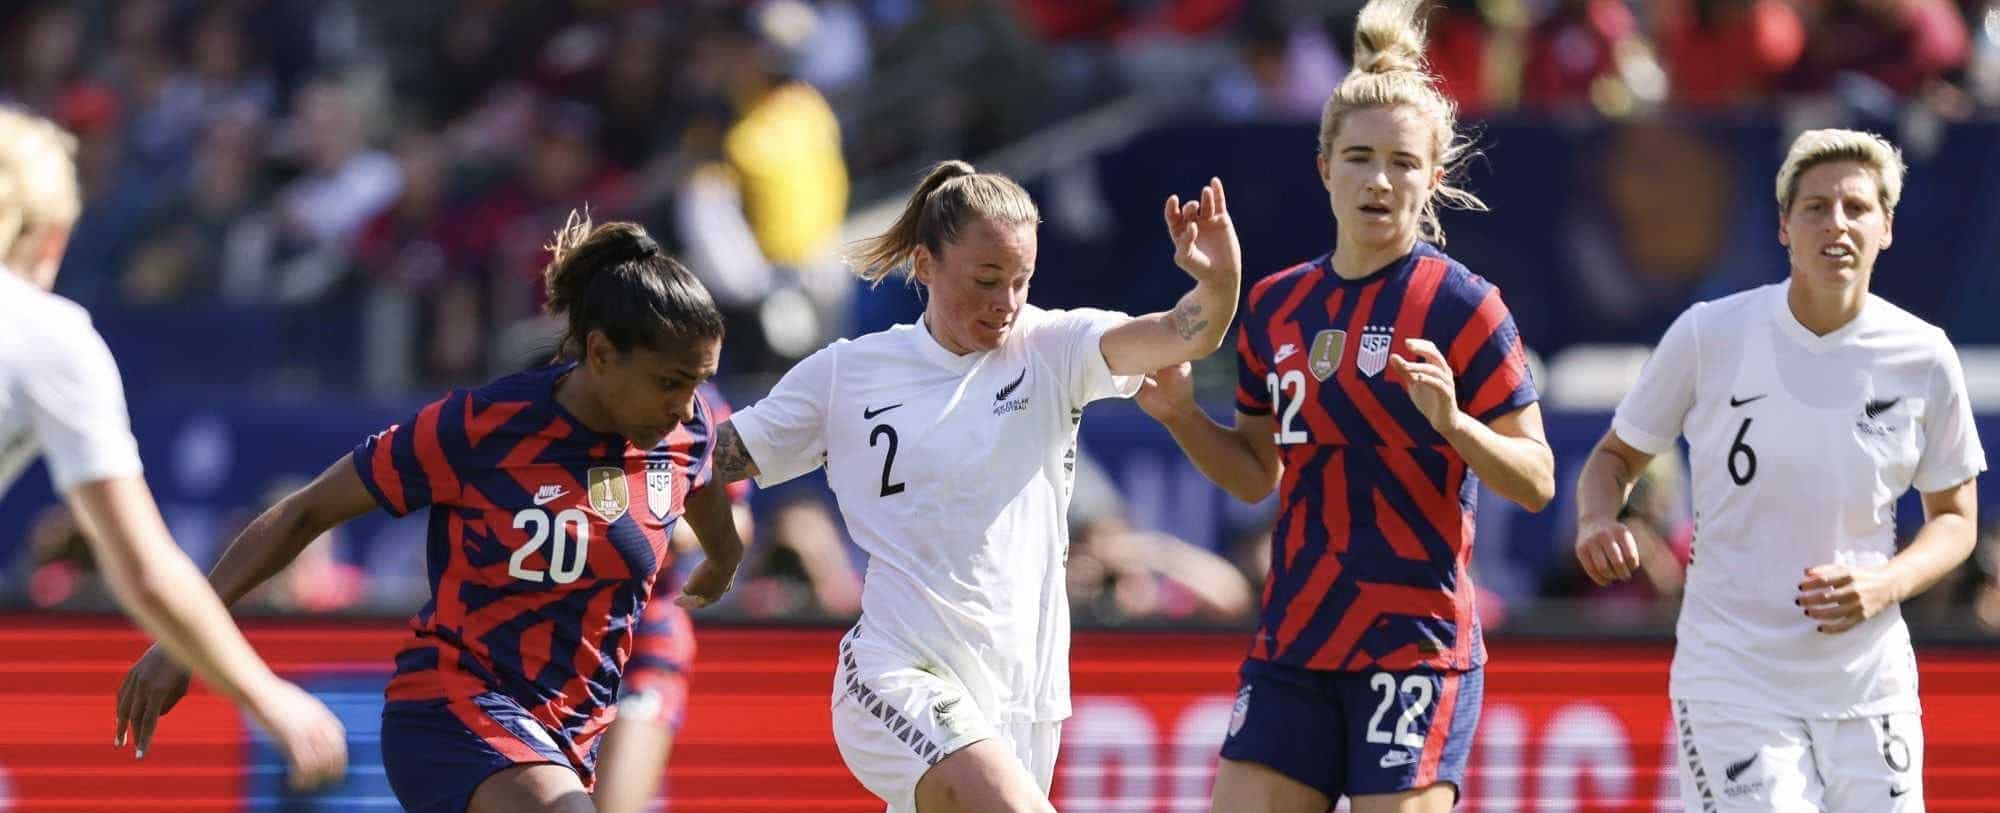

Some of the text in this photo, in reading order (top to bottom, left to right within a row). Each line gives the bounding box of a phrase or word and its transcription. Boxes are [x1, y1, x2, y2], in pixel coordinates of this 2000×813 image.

[870, 423, 905, 497] 2
[1728, 417, 1757, 486] 6
[538, 484, 562, 498] NIKE
[508, 508, 590, 584] 20
[1366, 672, 1433, 748] 22
[1881, 713, 1911, 773] 6
